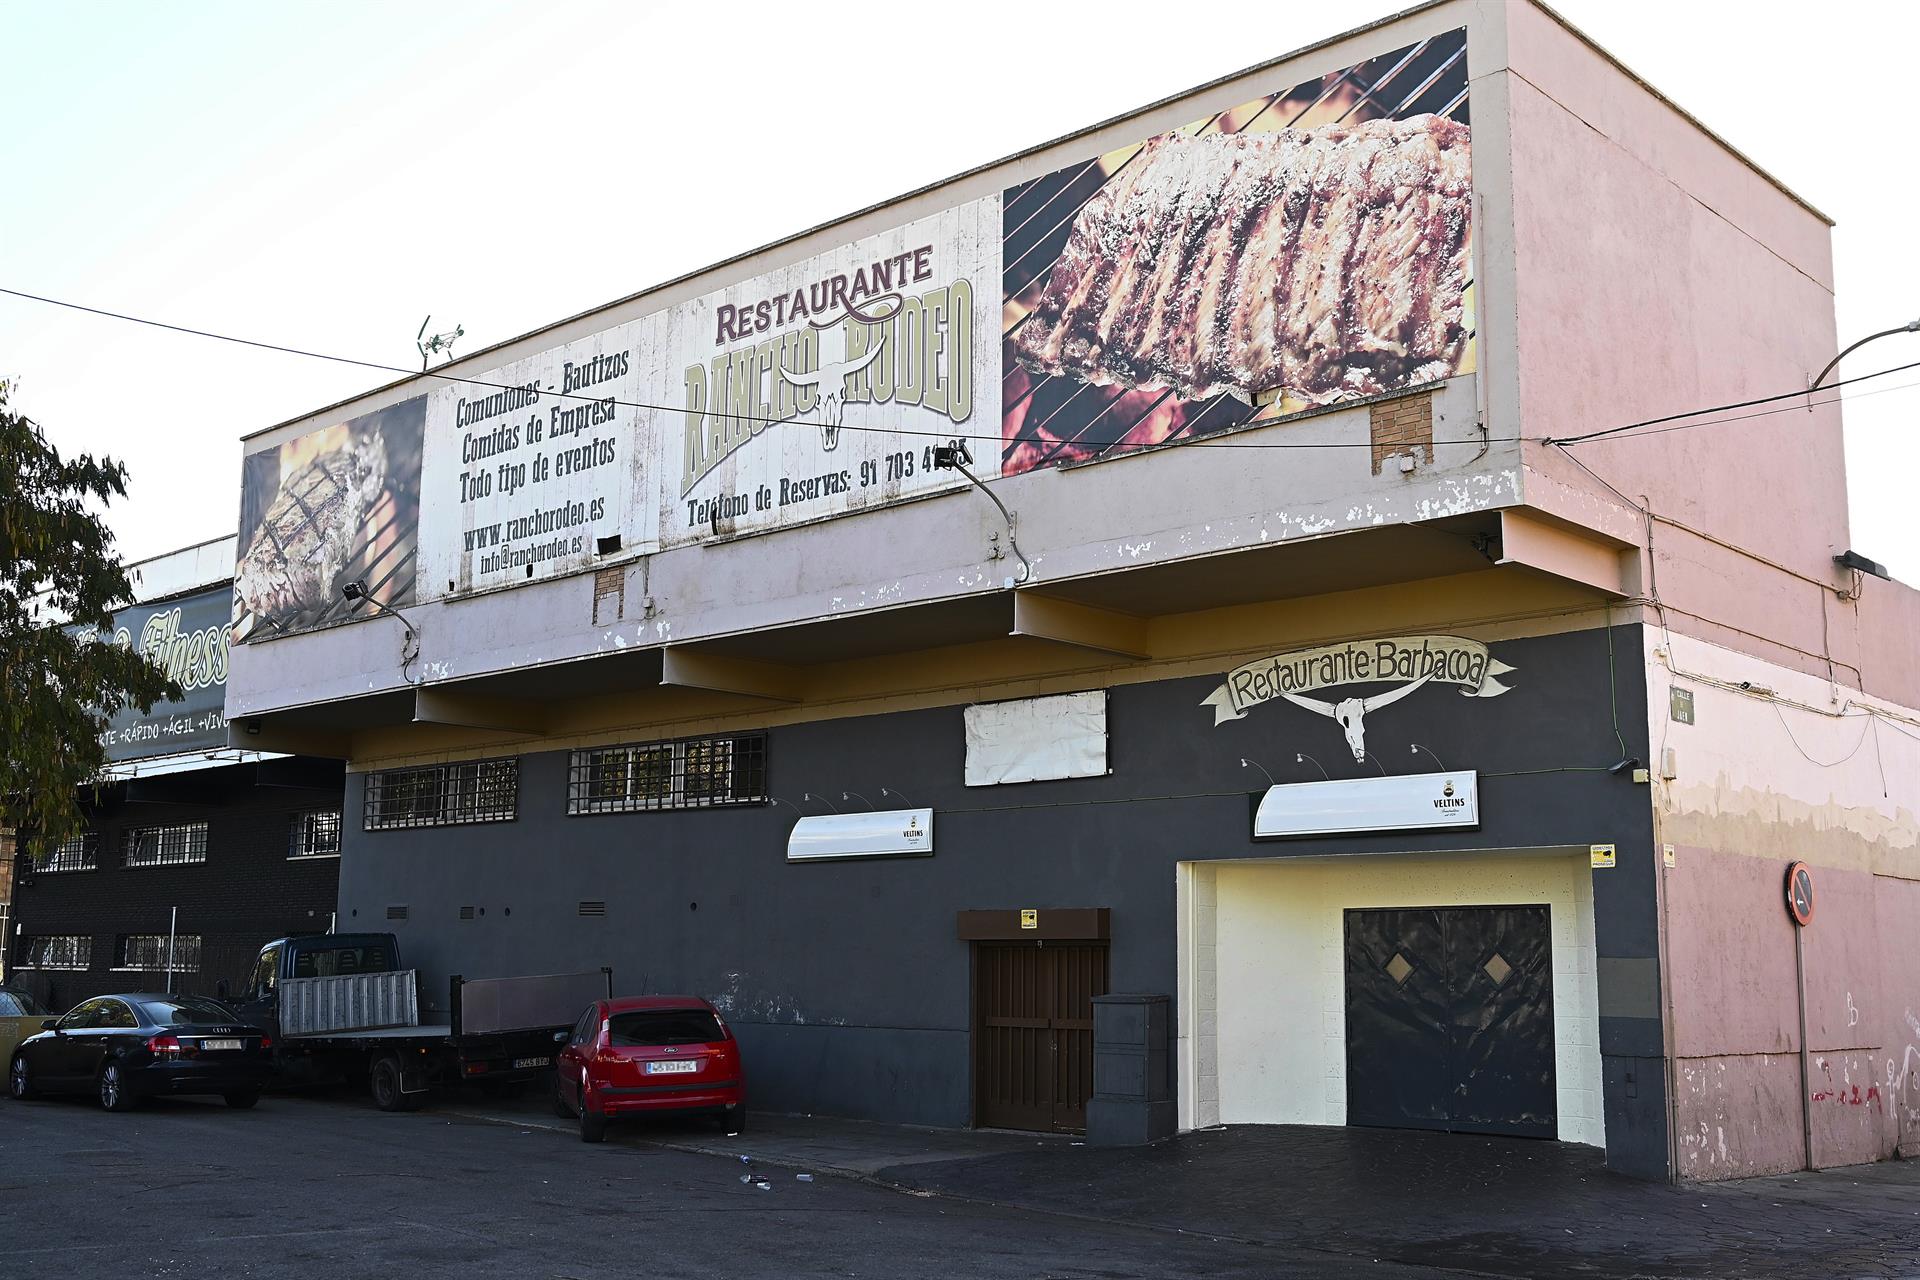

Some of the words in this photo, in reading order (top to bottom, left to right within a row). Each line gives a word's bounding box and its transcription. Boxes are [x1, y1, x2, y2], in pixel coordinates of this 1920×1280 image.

[715, 244, 934, 346] RESTAURANTE
[456, 379, 541, 429] Comuniones
[562, 350, 630, 395] Bautizos
[680, 326, 819, 499] RANCHO
[843, 277, 973, 425] RODEO
[462, 424, 519, 464] Comidas
[526, 414, 543, 446] de
[549, 396, 616, 439] Empresa
[460, 468, 491, 504] Todo
[498, 460, 526, 496] tipo
[532, 451, 549, 484] de
[555, 436, 616, 478] eventos
[755, 484, 772, 512] de
[778, 469, 852, 506] Reservas:
[860, 458, 878, 488] 91
[885, 451, 914, 481] 703
[463, 496, 605, 552] www.ranchorodeo.es
[480, 535, 583, 575] info@ranchorodeo.es
[902, 830, 924, 838] VELTINS
[1433, 798, 1465, 808] VELTINS
